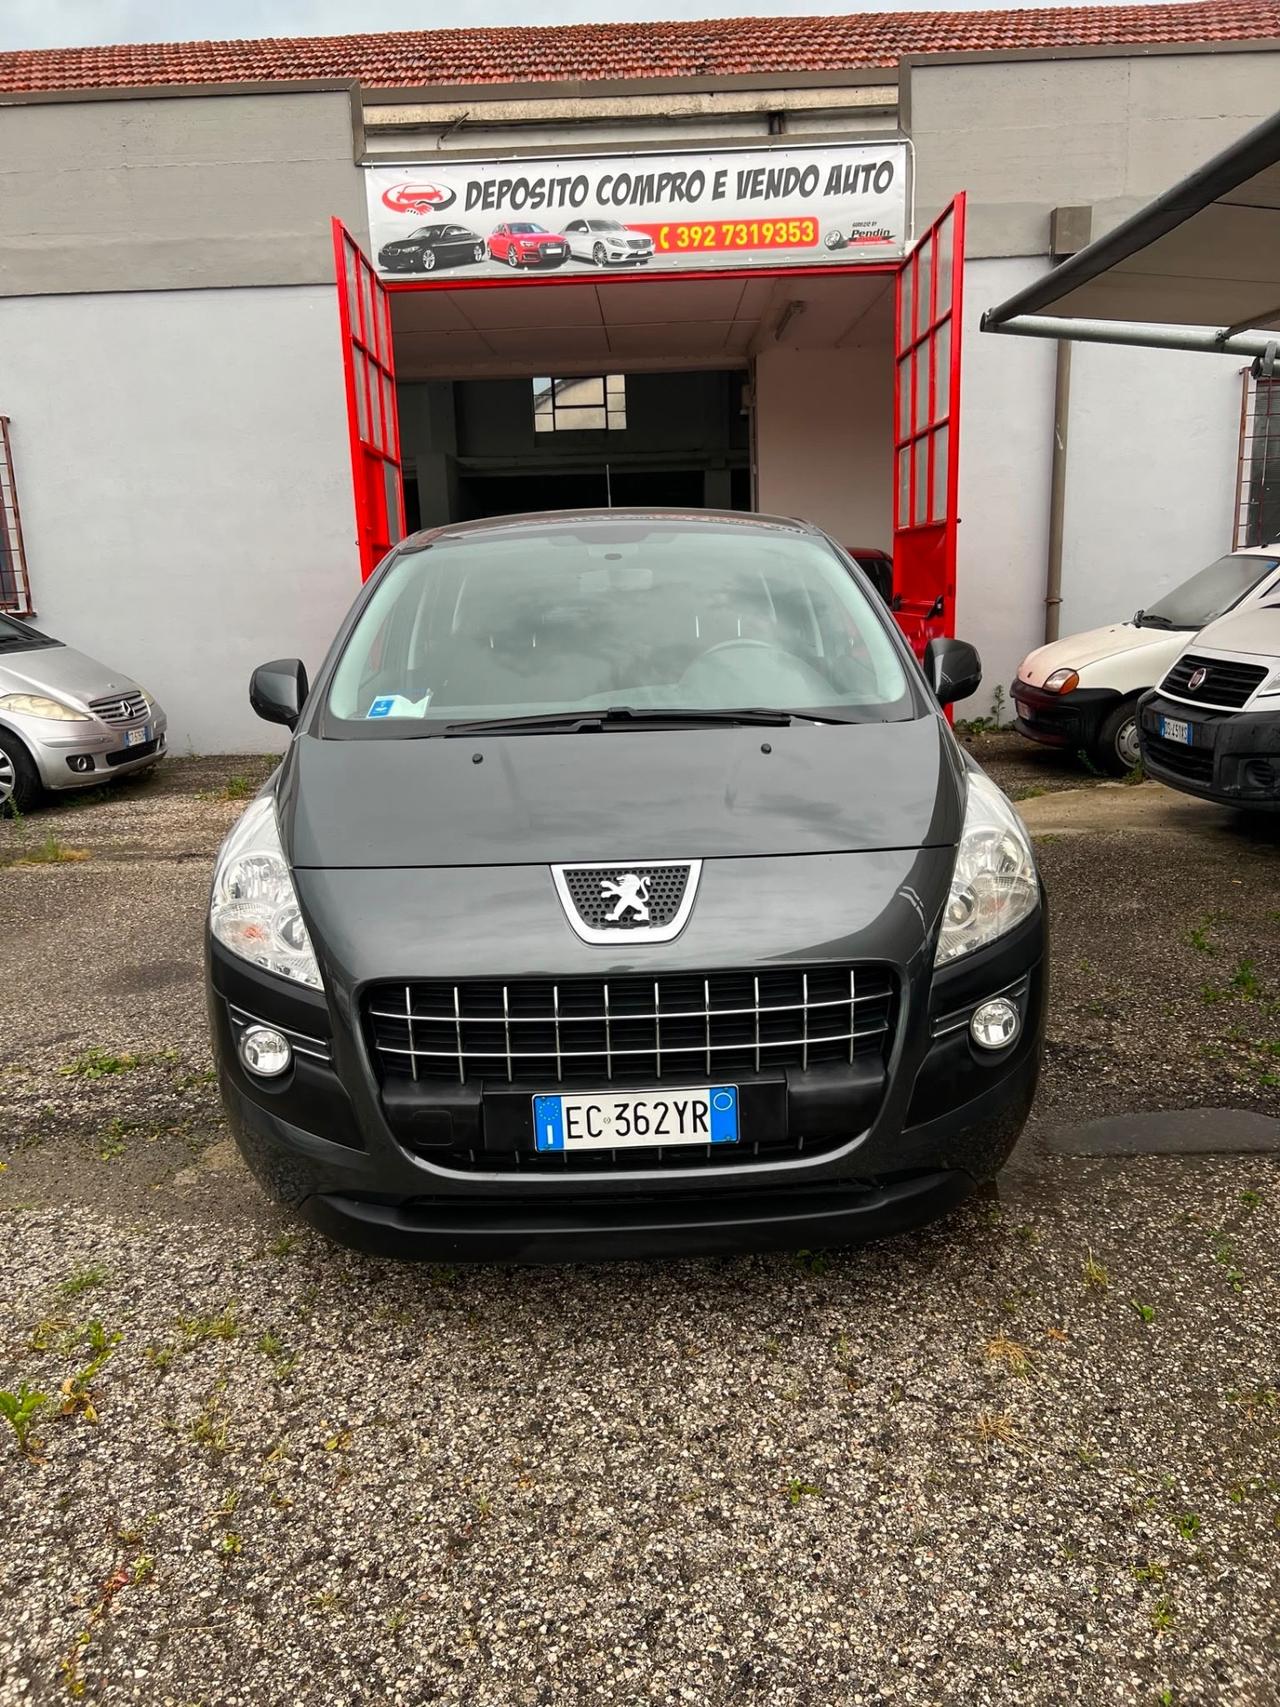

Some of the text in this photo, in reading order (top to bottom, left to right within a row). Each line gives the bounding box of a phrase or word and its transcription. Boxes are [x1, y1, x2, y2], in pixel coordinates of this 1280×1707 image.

[465, 160, 894, 212] DEPOSITO COMPRO E VENDO AUTO
[677, 221, 814, 248] 392 7319353
[566, 1100, 708, 1139] EC 362YR
